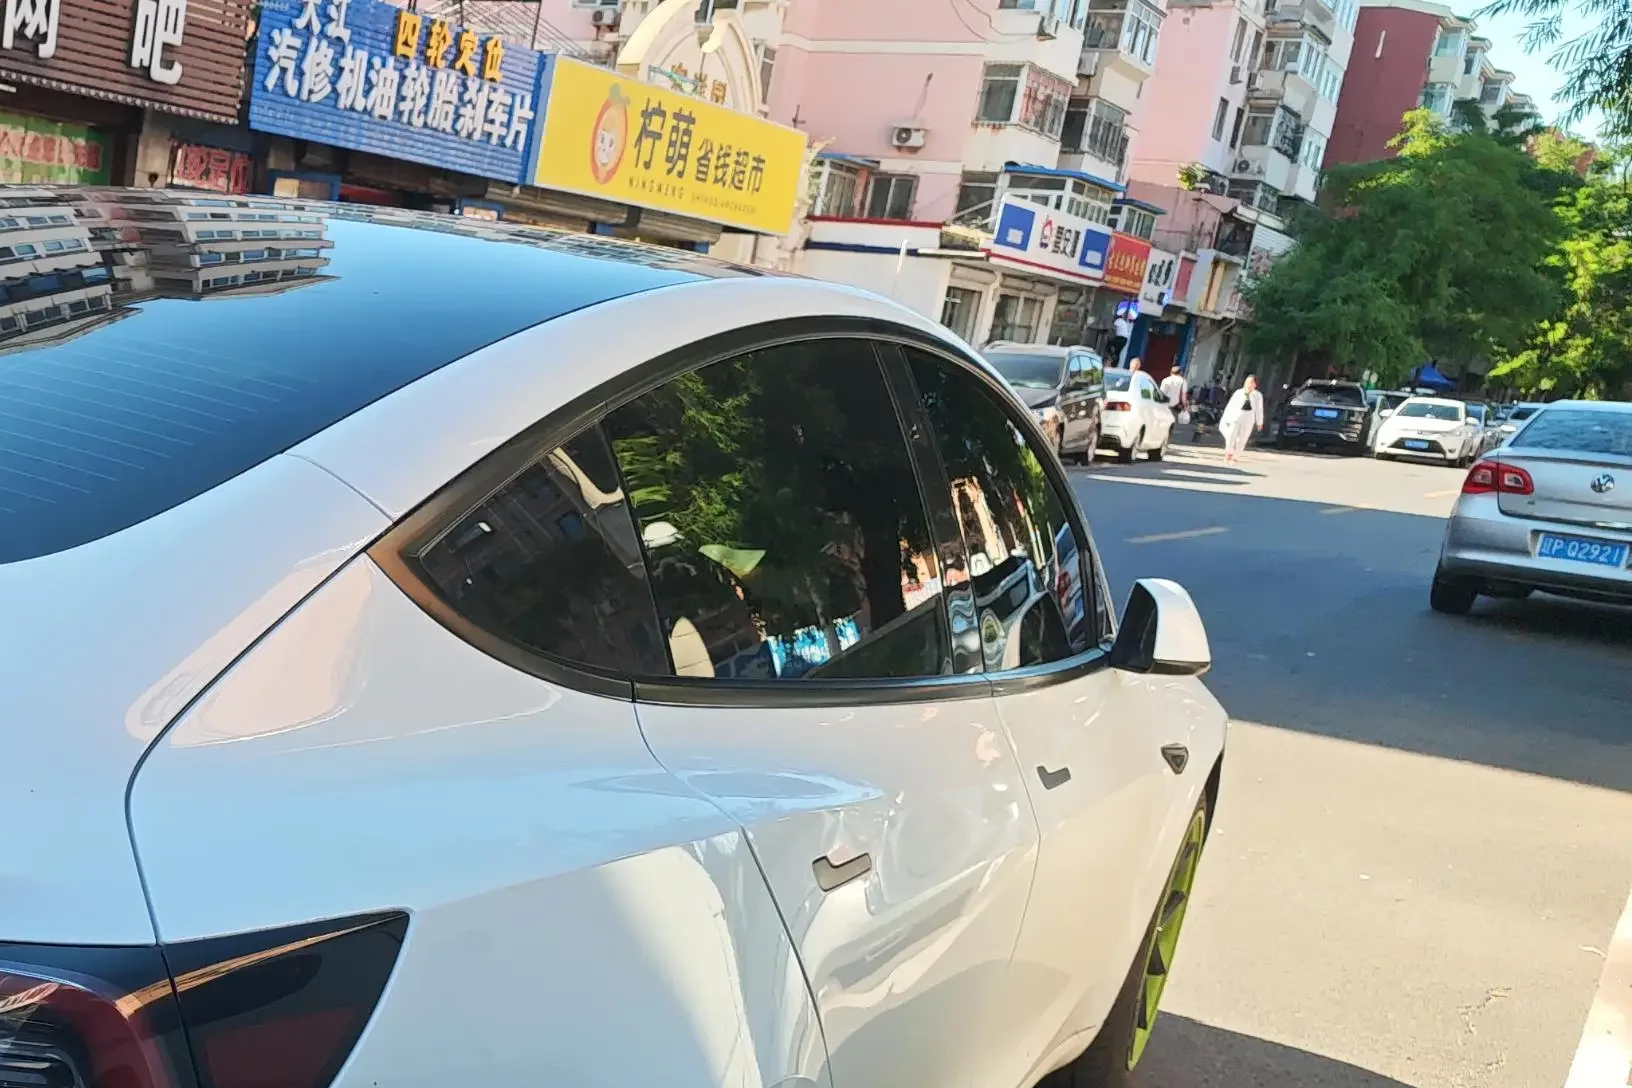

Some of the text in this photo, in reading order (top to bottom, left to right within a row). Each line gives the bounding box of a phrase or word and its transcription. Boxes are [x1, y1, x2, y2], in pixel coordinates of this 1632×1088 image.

[264, 27, 535, 151] 汽修机油轮胎刹车片
[395, 10, 505, 83] 四轮定位
[633, 97, 766, 195] 柠萌 省钱超市
